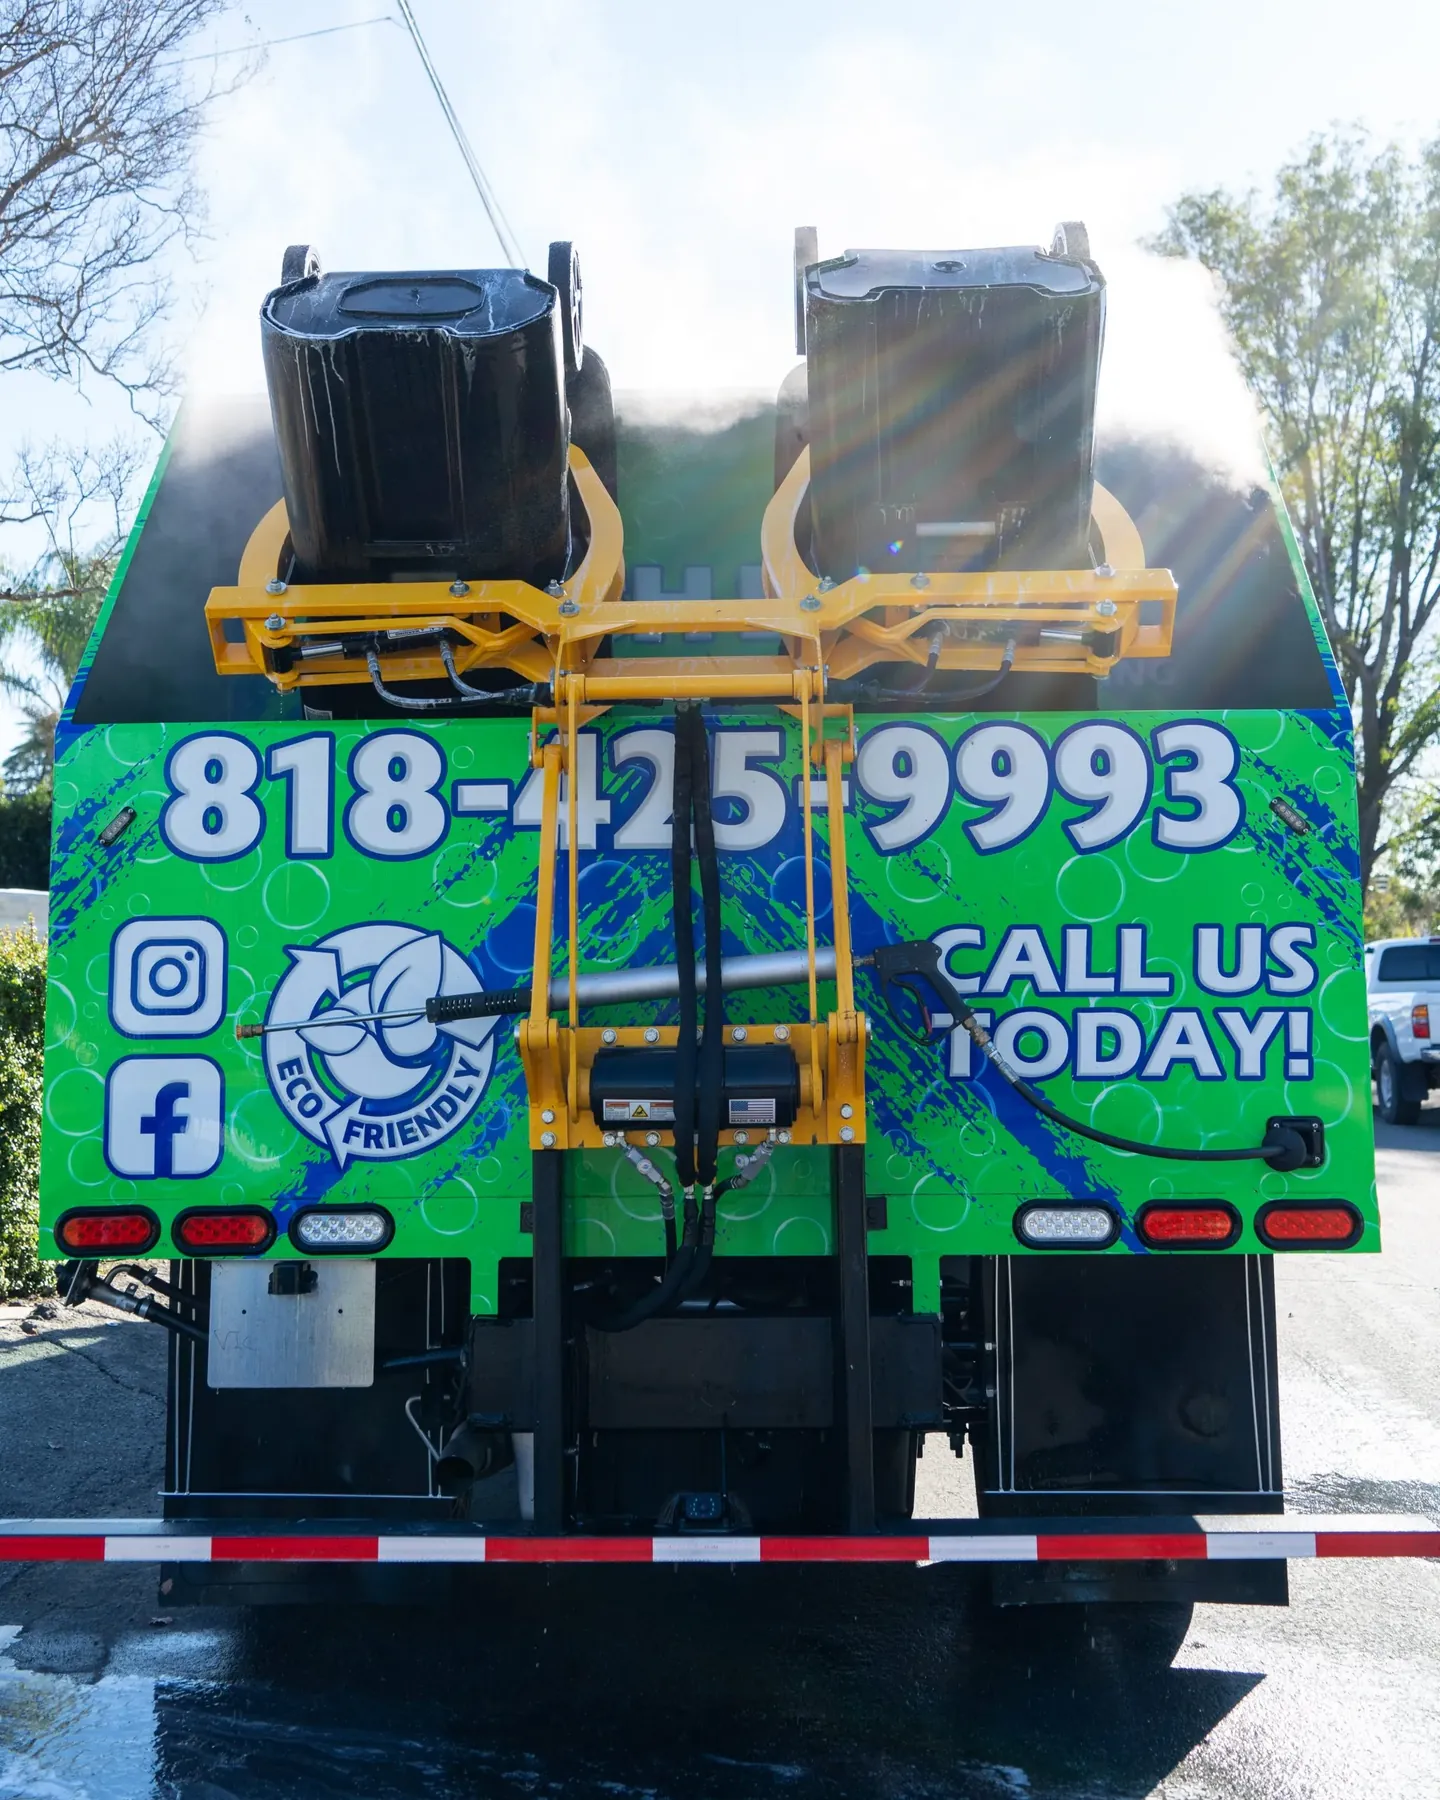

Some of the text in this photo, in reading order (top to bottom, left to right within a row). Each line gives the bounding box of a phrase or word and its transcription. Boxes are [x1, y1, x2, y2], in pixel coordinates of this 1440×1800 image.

[163, 723, 1243, 860] 818-425-9993
[938, 925, 1315, 993] CALL US
[932, 1010, 1315, 1079] TODAY!
[275, 1058, 325, 1120] ECO
[342, 1056, 482, 1150] FRIENDLY
